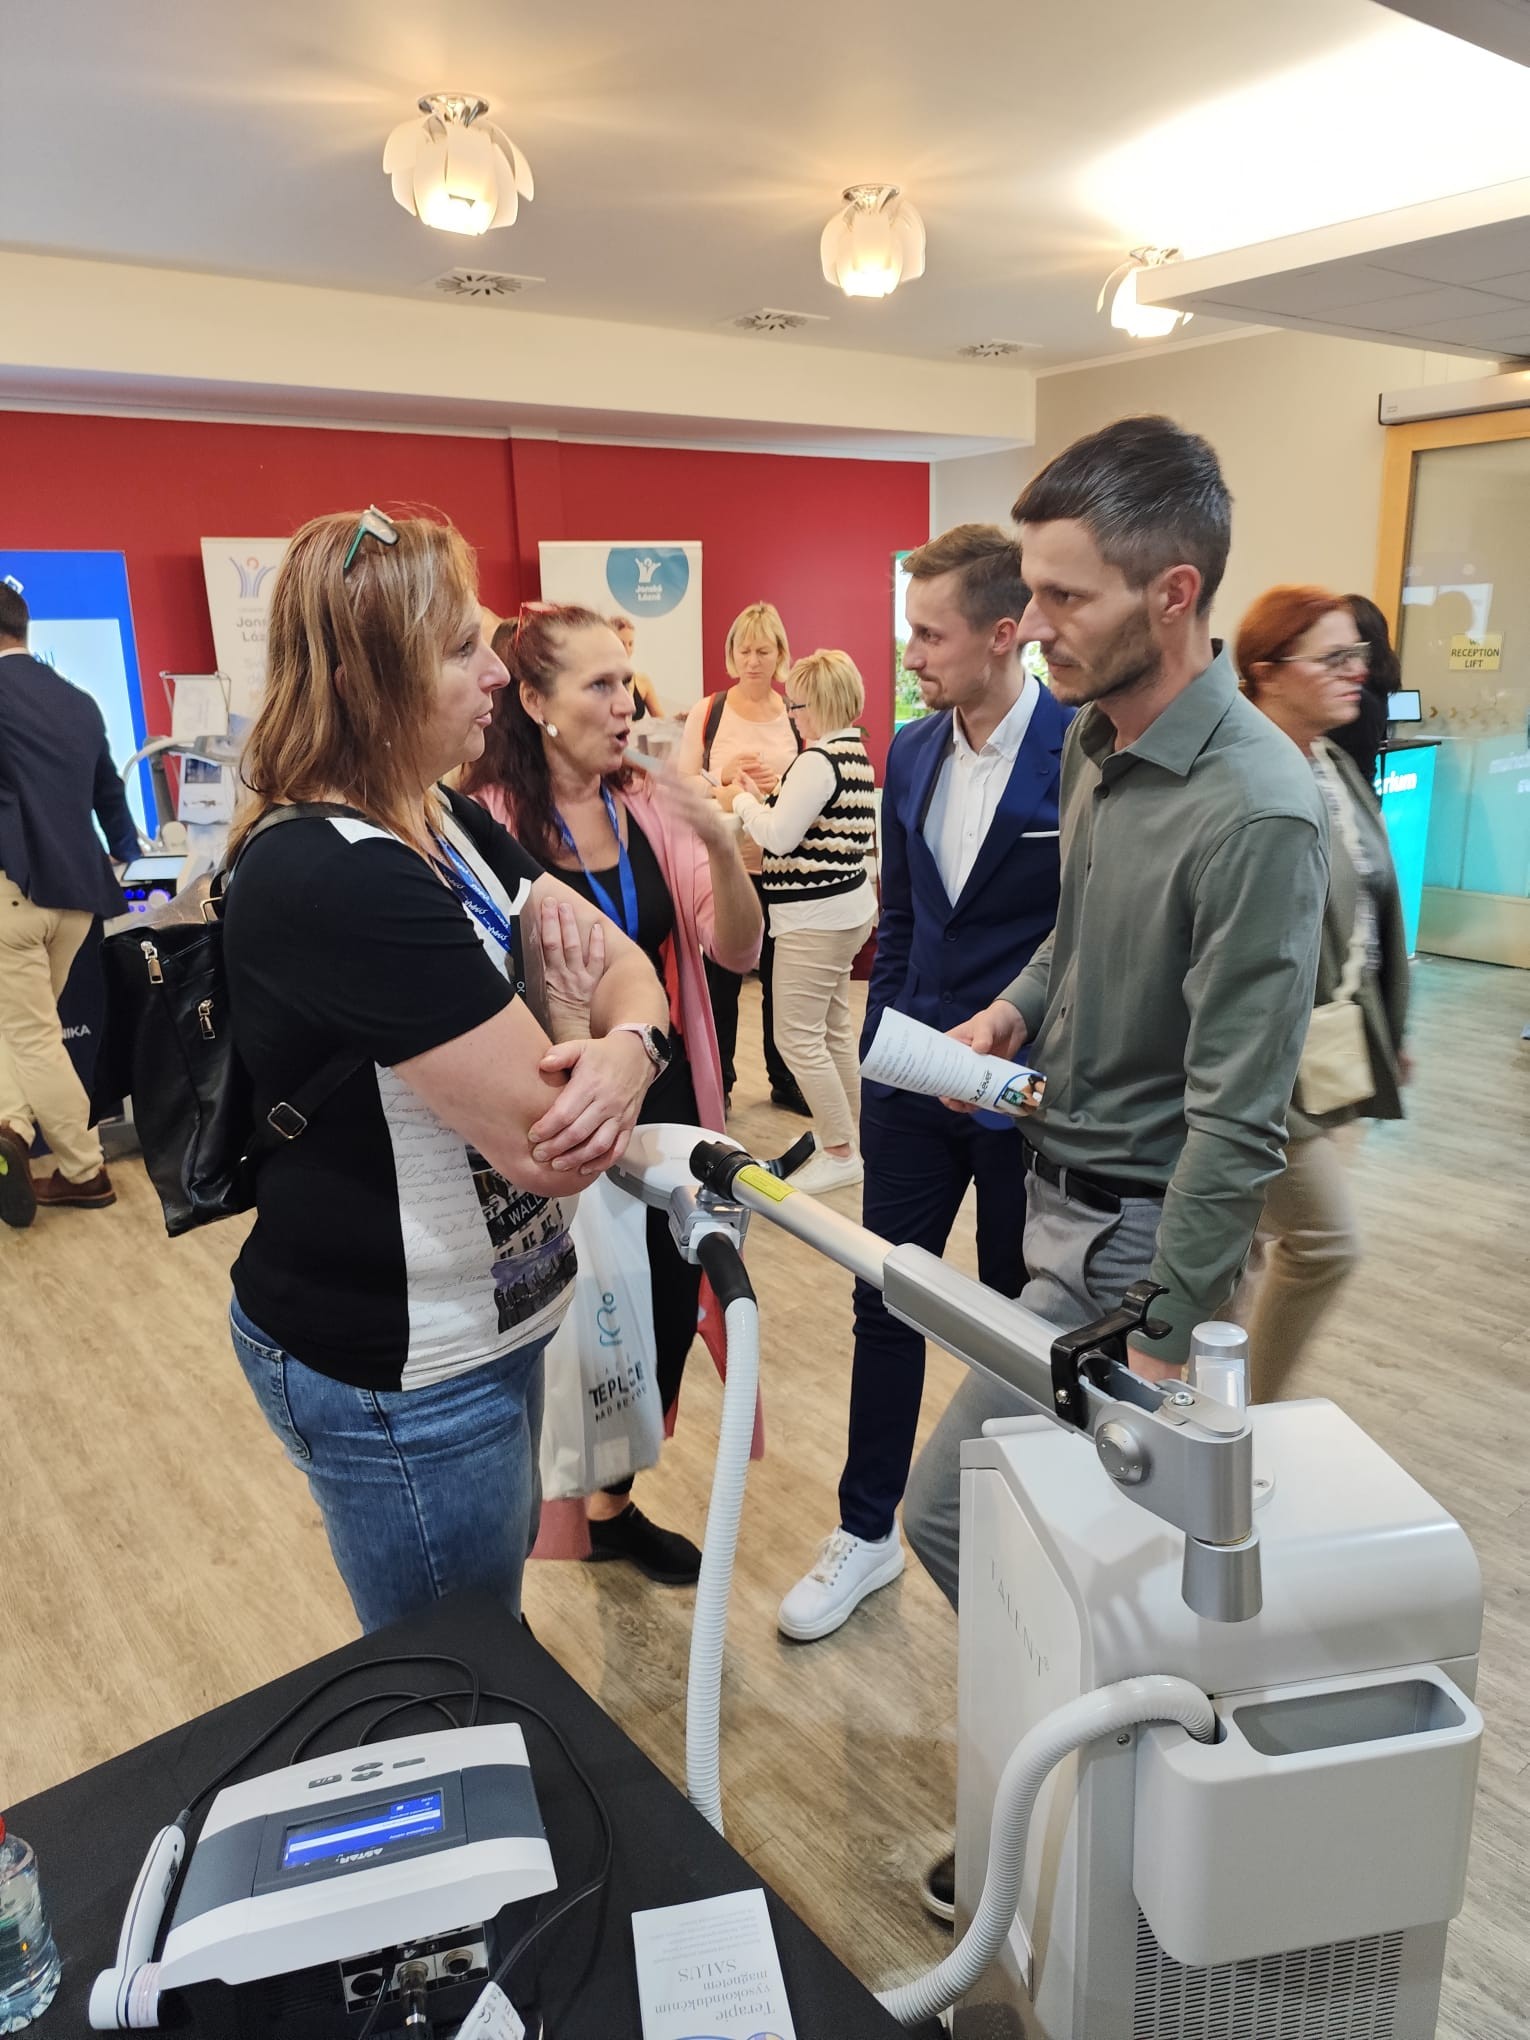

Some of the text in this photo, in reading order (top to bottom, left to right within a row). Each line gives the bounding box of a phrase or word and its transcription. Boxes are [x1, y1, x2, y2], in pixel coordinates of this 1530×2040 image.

[1451, 648, 1500, 657] RECEPTION
[1464, 659, 1483, 668] LIFT
[339, 1847, 383, 1864] ASTAR
[678, 1959, 737, 1982] SALUS
[703, 1970, 768, 1991] magnetem
[715, 2001, 775, 2022] Terapie
